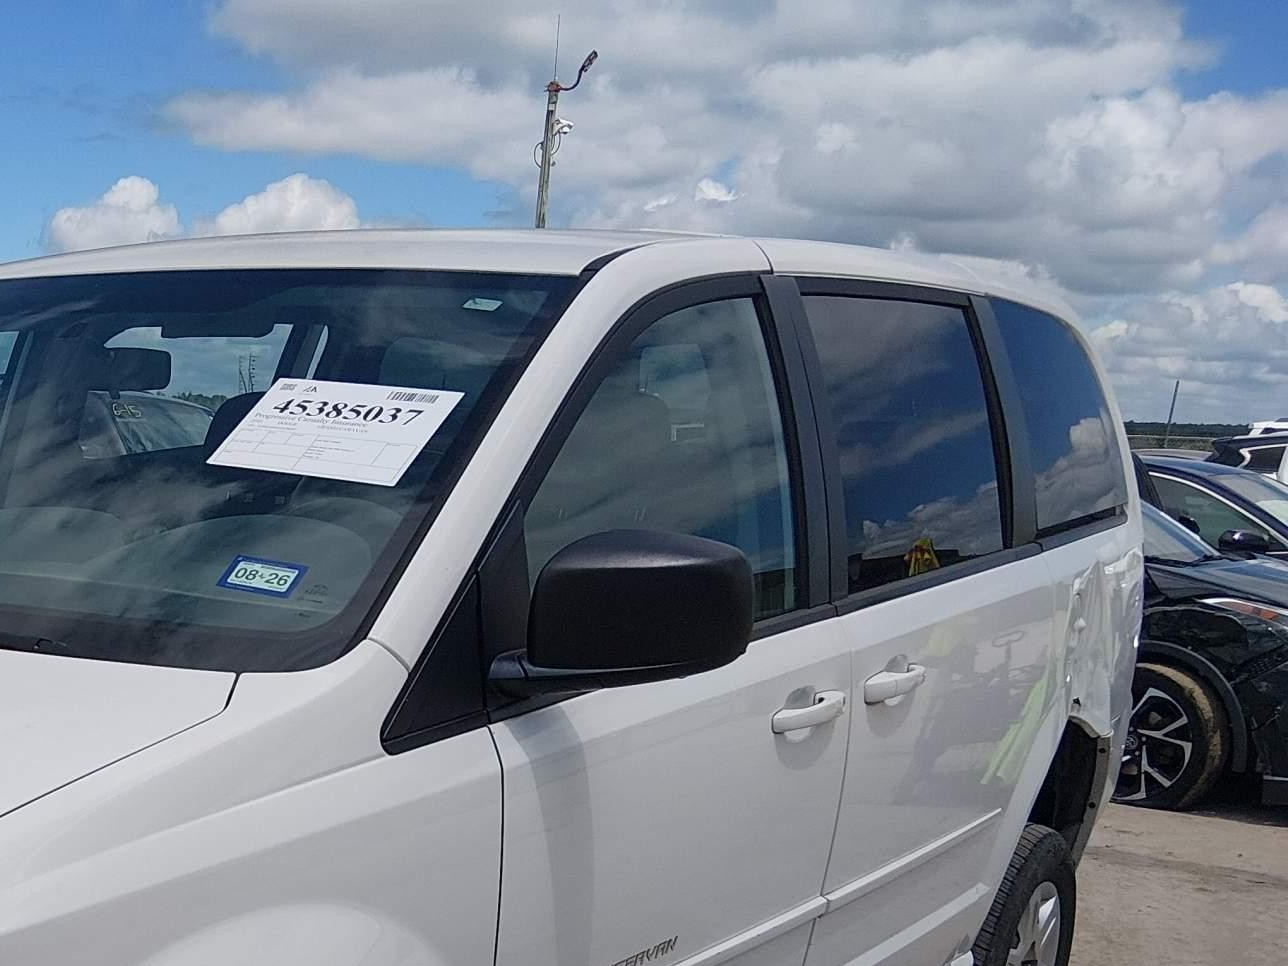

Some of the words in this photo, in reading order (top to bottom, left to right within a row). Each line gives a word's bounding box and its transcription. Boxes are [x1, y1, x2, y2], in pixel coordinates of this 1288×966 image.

[273, 398, 424, 426] 45385037
[330, 420, 368, 428] Insurance
[234, 567, 259, 581] 08
[264, 572, 290, 586] 26
